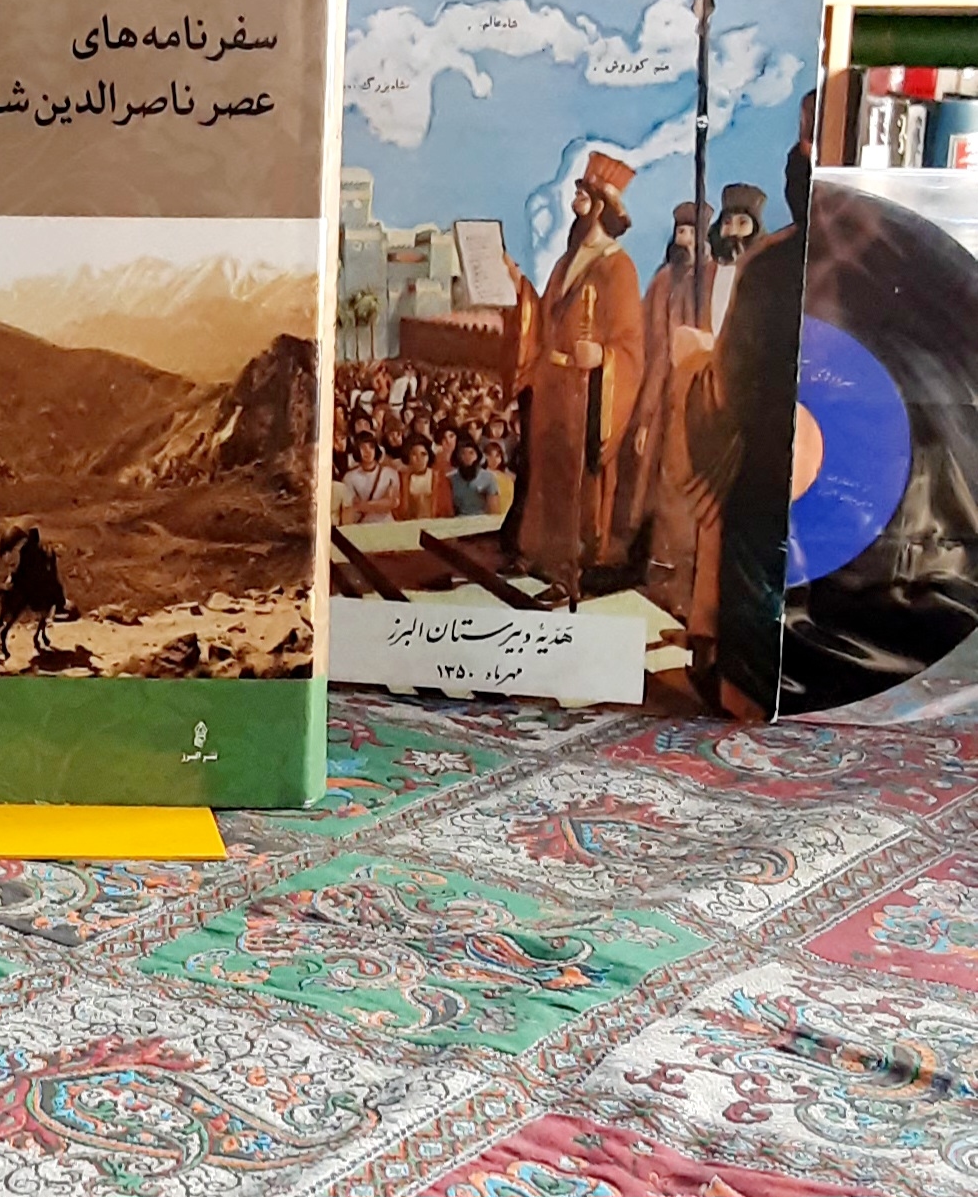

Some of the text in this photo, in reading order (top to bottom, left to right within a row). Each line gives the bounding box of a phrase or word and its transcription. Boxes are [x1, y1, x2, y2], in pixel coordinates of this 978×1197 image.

[198, 91, 276, 126] عصر
[387, 617, 424, 646] البرز
[426, 618, 531, 654] دبیرستان
[437, 664, 475, 680] ۱۳۵۰
